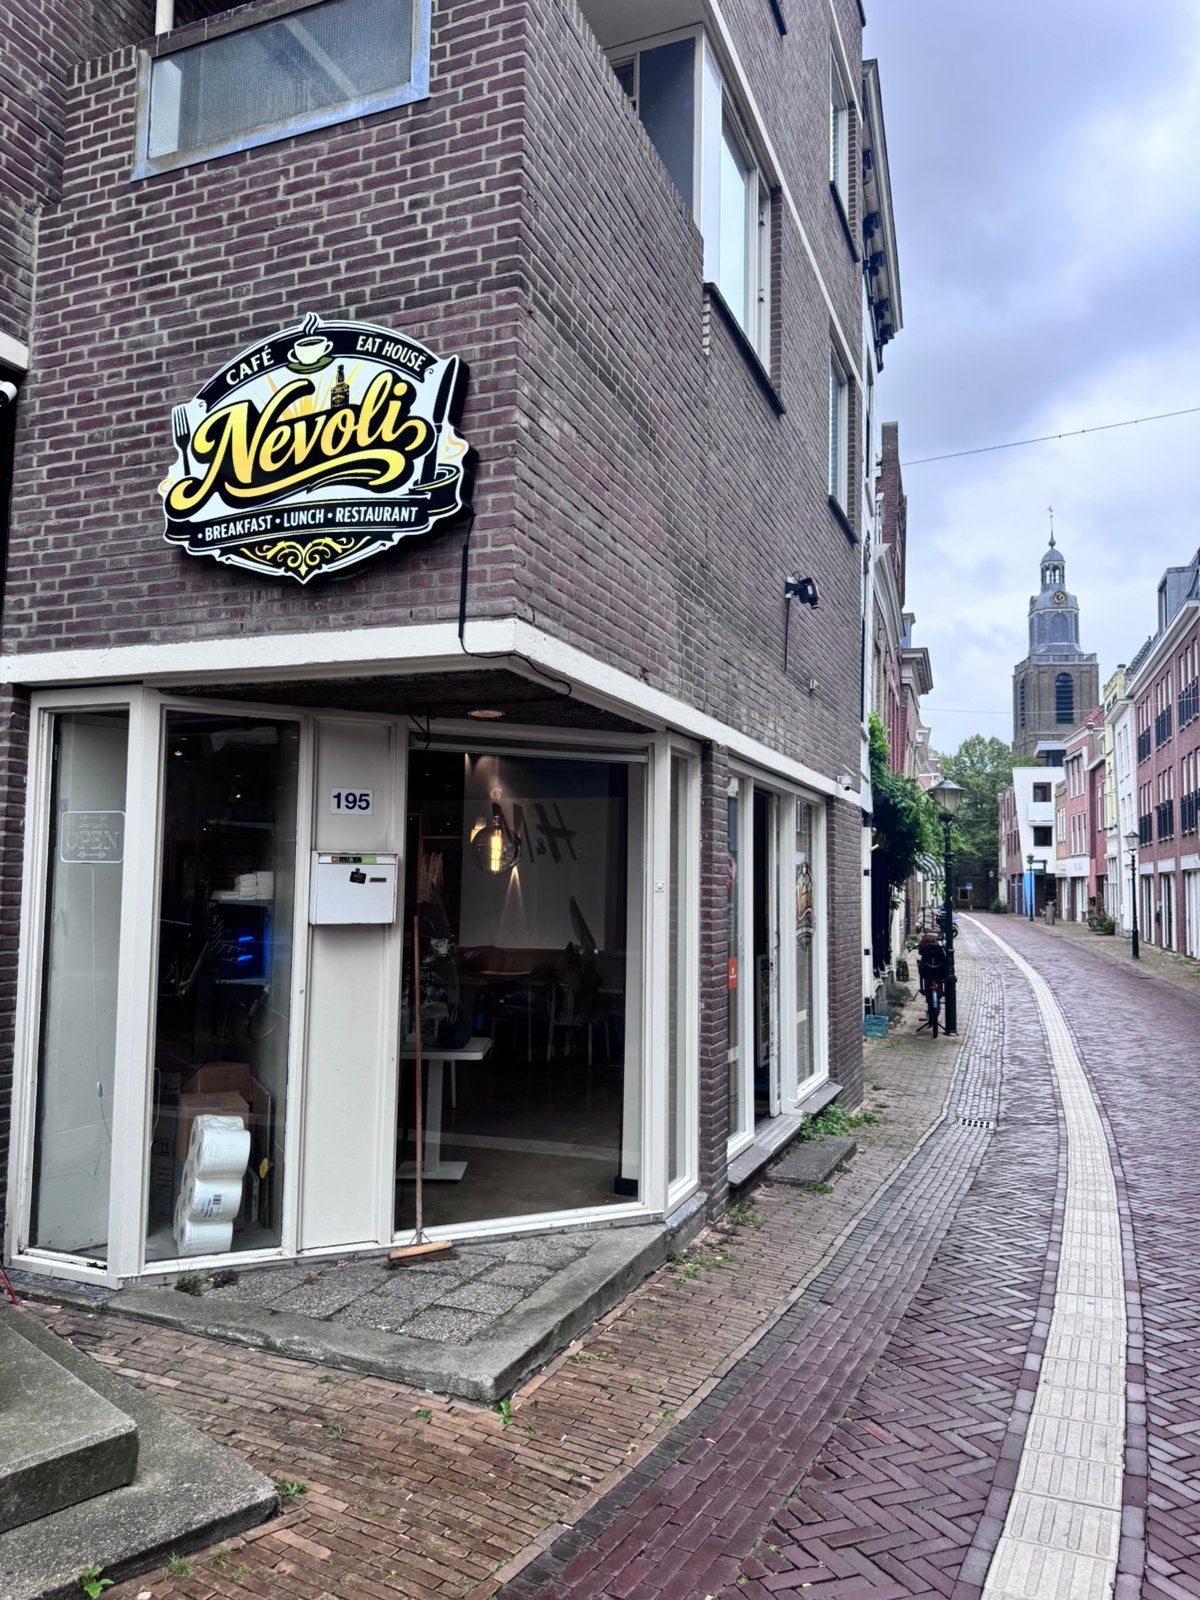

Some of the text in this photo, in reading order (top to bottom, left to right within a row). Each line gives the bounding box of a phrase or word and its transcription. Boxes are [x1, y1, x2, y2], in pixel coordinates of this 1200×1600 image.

[226, 335, 426, 386] CAFÉ EAT HOUSE
[170, 371, 427, 511] Nevoli
[205, 506, 418, 541] BREAKFAST LUNCH RESTAURANT
[333, 792, 370, 810] 195
